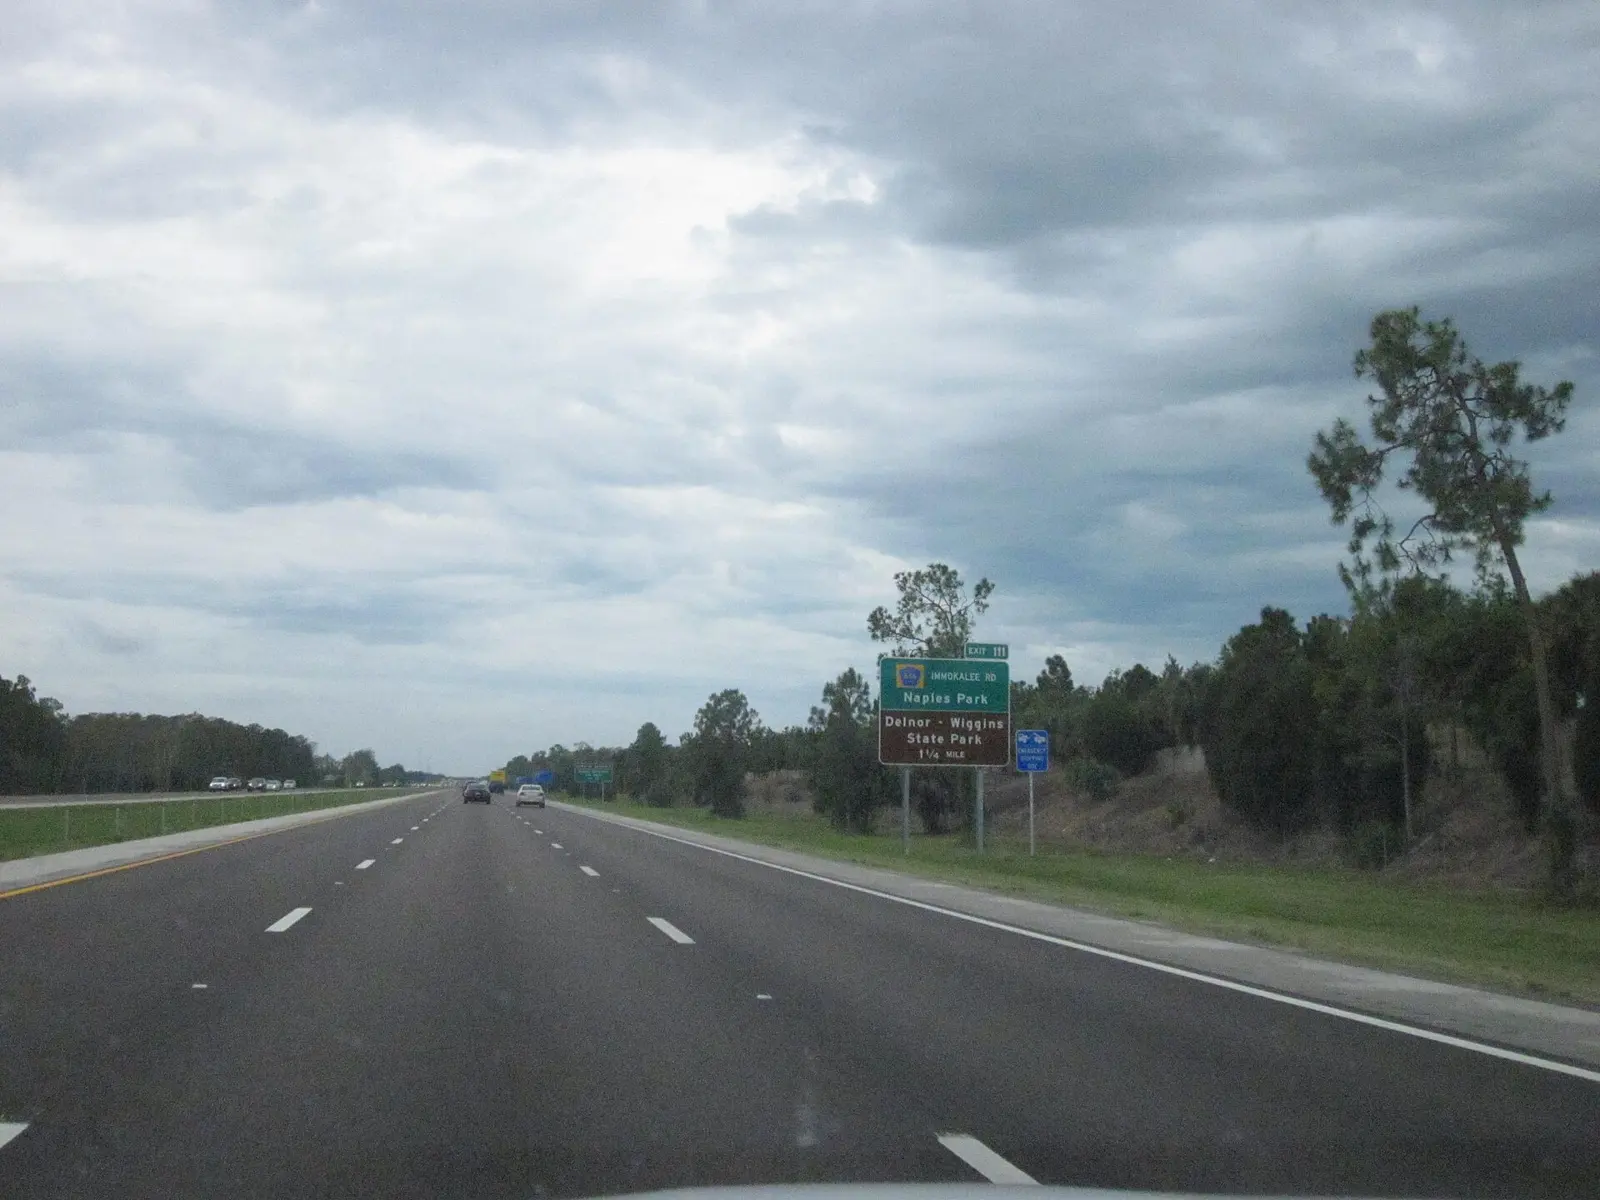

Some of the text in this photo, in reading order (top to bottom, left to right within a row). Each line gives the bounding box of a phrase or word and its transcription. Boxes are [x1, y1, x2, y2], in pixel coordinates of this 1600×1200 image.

[968, 646, 1006, 657] EXIT 111
[931, 671, 997, 682] IMMOKALEE RD
[903, 692, 988, 705] Naples Park
[885, 716, 931, 727] Delnor
[950, 717, 1004, 731] Wiggins
[907, 732, 982, 745] State Park
